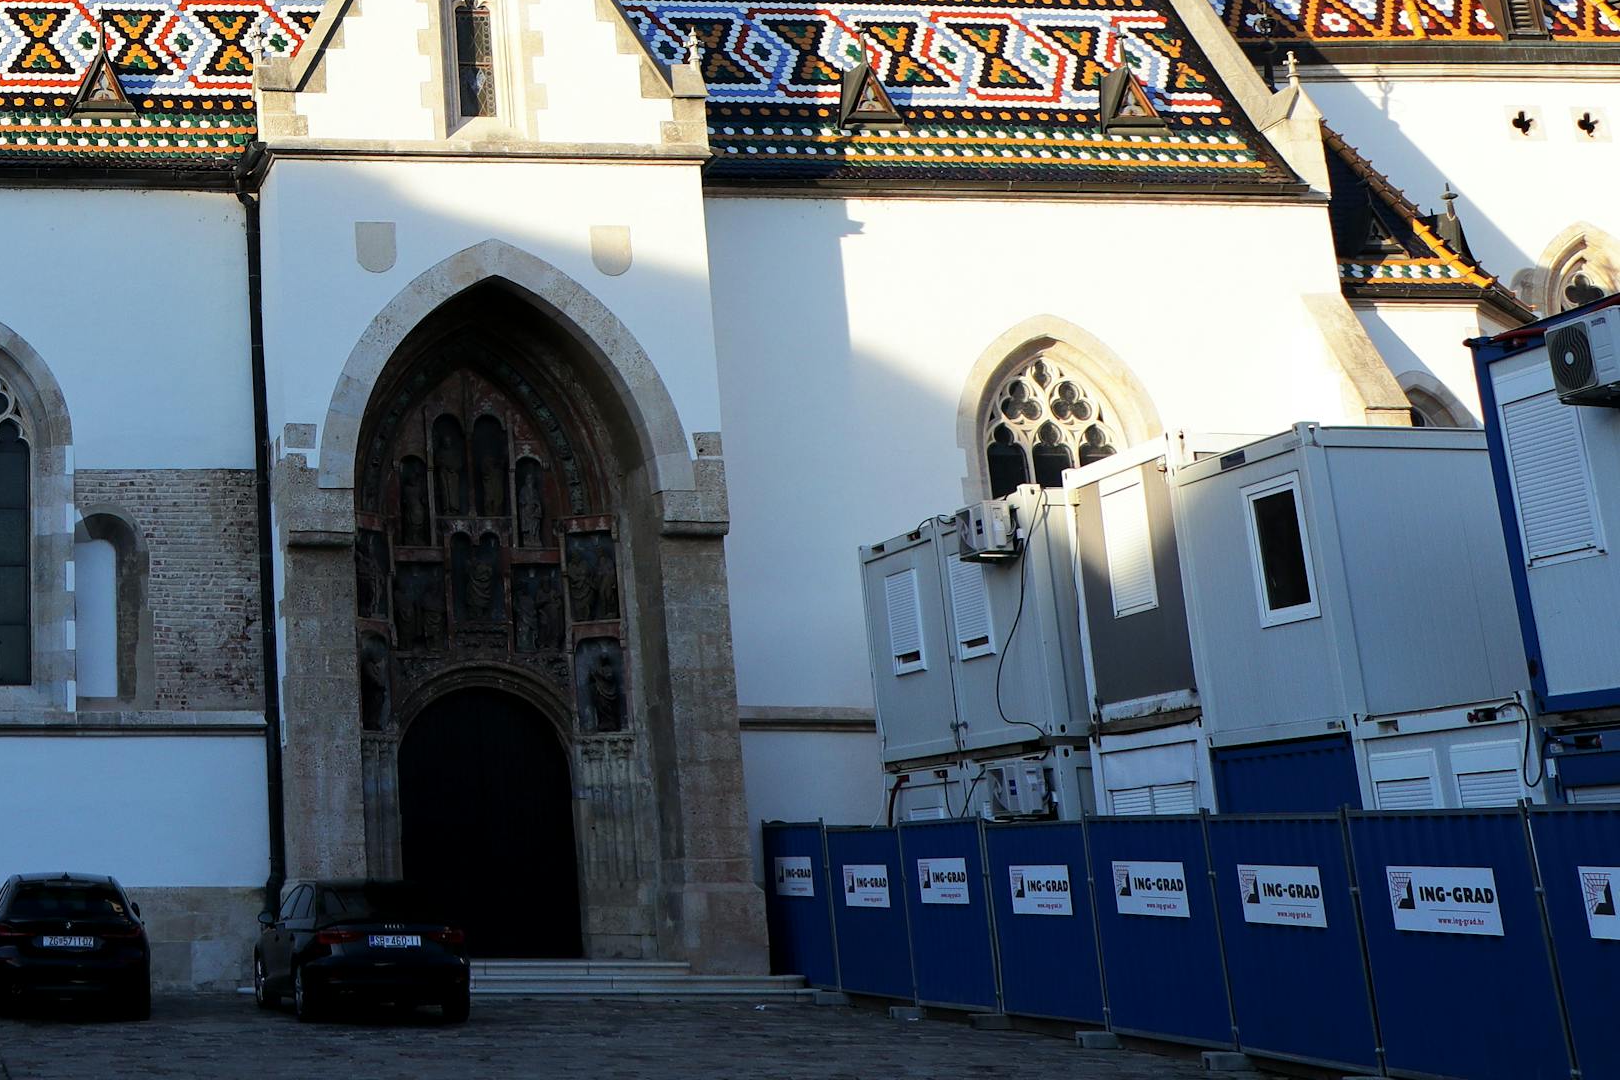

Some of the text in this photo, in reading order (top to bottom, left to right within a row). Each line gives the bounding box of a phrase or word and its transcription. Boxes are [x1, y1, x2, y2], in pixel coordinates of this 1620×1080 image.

[856, 877, 887, 888] ING-GRAD
[932, 872, 966, 883] ING-GRAD
[1027, 880, 1069, 892] ING-GRAD
[1134, 877, 1184, 892] ING-GRAD
[1262, 883, 1320, 899] ING-GRAD
[1419, 886, 1494, 904] ING-GRAD
[1437, 917, 1484, 926] www.ing-grad.hr
